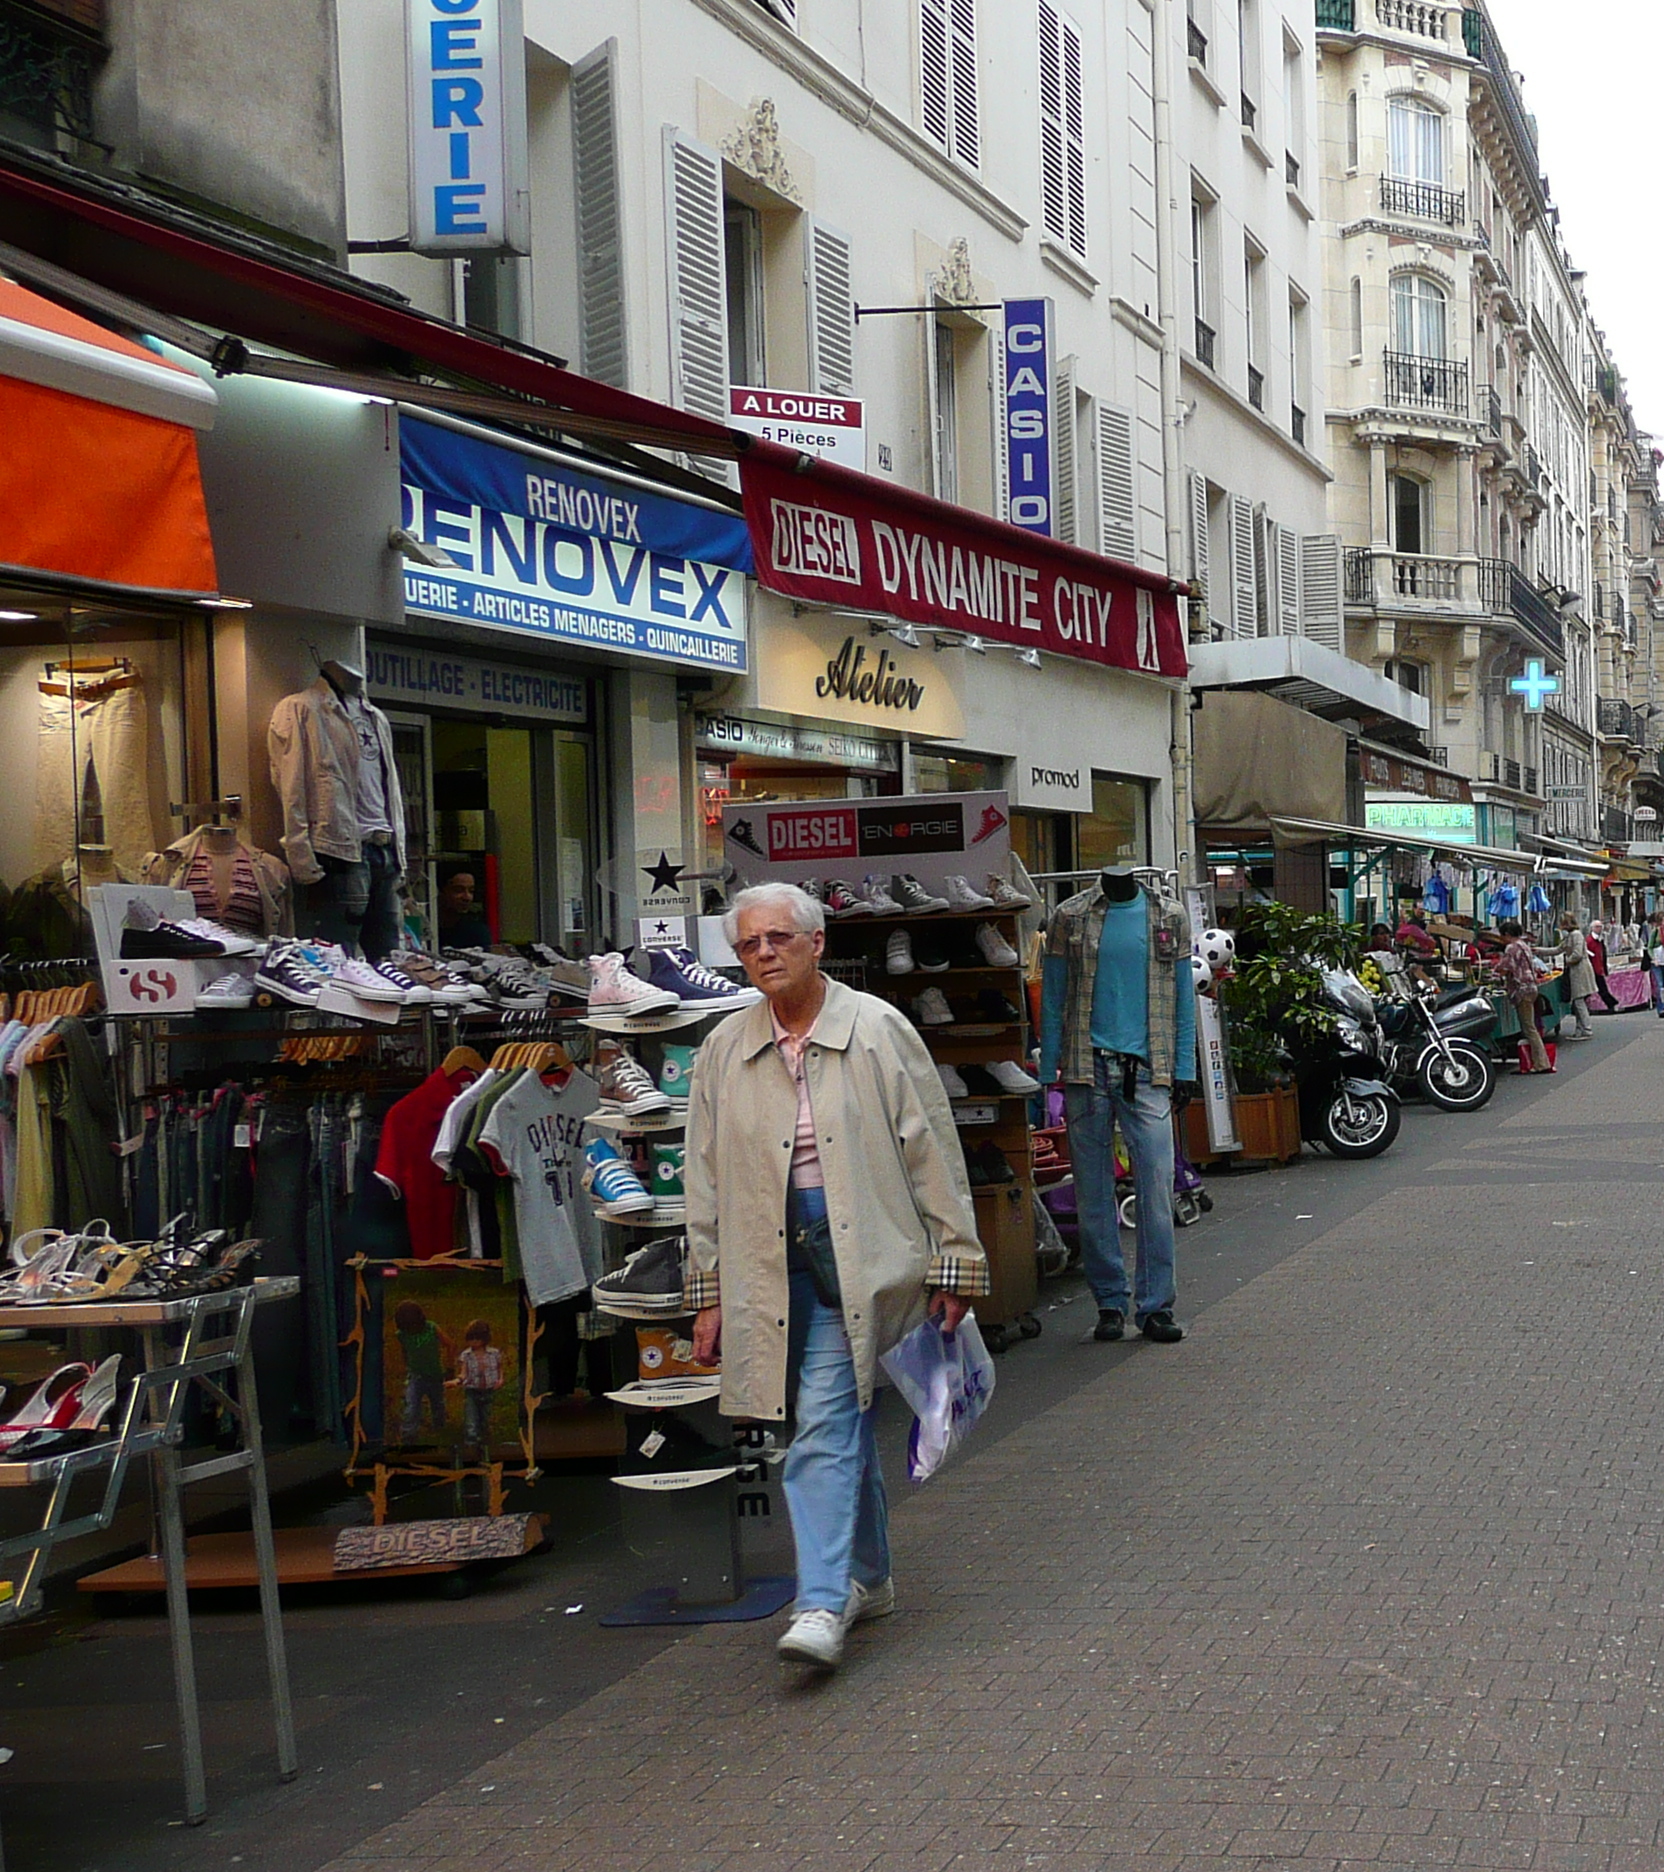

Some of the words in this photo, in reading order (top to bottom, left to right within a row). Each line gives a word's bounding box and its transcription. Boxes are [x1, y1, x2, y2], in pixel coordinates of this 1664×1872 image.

[430, 0, 488, 236] ERIE
[743, 394, 760, 411] A
[767, 397, 847, 422] LOUER
[1007, 324, 1048, 525] CASIO
[761, 427, 772, 443] 5
[777, 425, 837, 448] Pièces
[526, 474, 643, 544] RENOVEX
[774, 502, 859, 580] DIESEL
[871, 519, 1041, 631] DYNAMITE
[1053, 575, 1112, 649] CITY
[473, 590, 550, 629] ARTICLES
[554, 608, 636, 645] MENAGERS
[647, 627, 738, 665] QUINCAILLERIE
[481, 669, 583, 713] ELECTRICITE
[816, 636, 925, 711] Atelier
[1031, 765, 1080, 791] promod
[1552, 786, 1588, 799] MERCERIE
[772, 816, 852, 850] DIESEL
[1368, 803, 1475, 828] PHARMACIE
[373, 1525, 487, 1553] DIESEL
